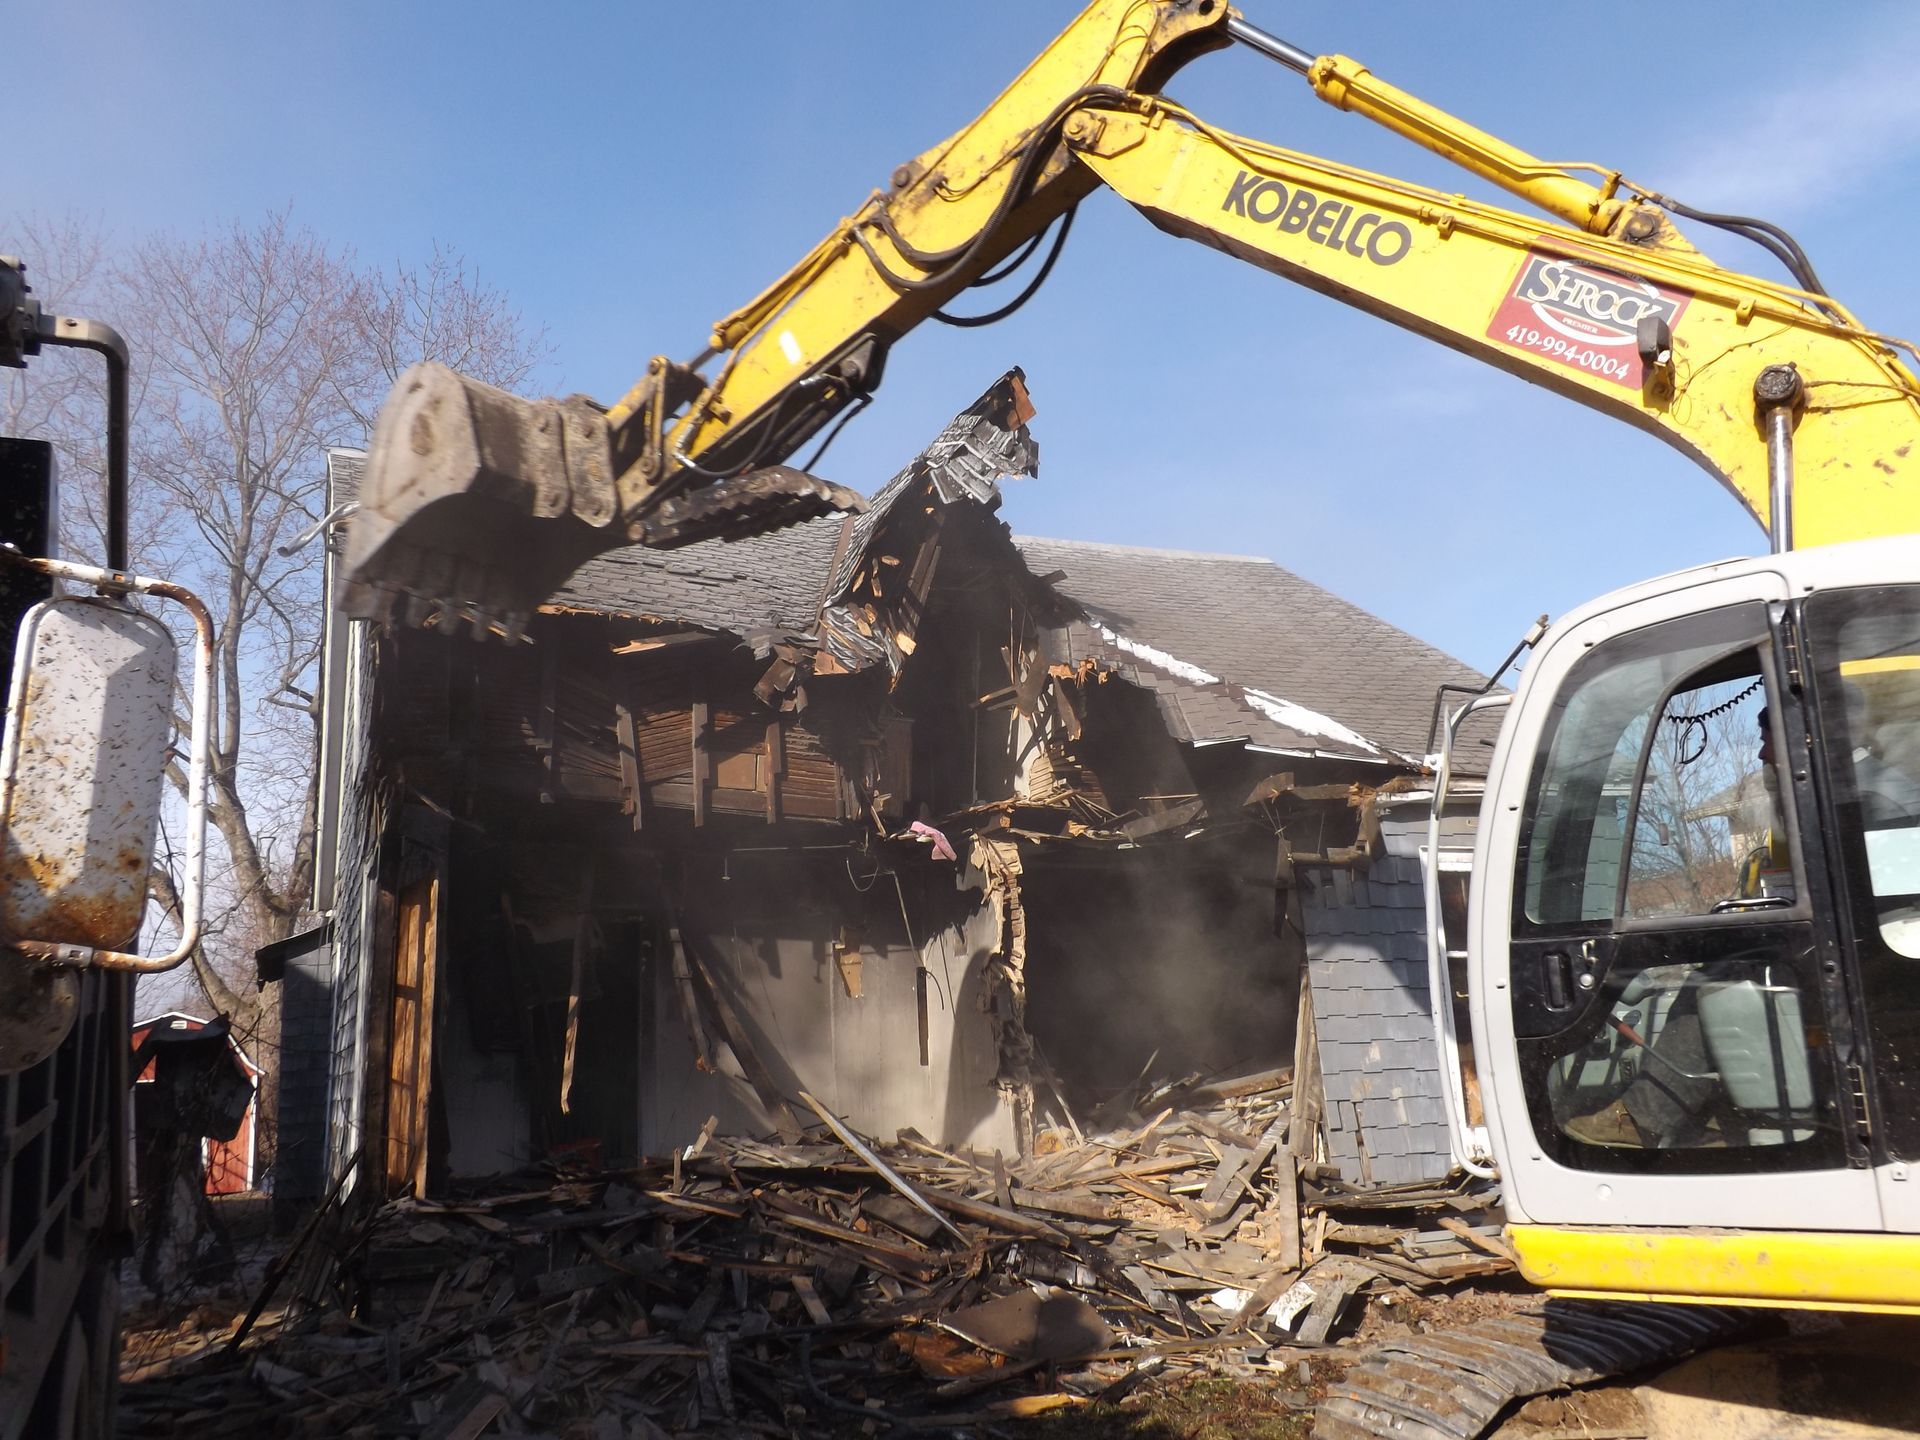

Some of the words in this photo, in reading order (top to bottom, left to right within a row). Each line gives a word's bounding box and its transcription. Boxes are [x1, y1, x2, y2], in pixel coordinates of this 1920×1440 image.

[1221, 170, 1412, 266] KOBELCO
[1527, 263, 1663, 329] SHROCK
[1506, 324, 1630, 380] 419-994-0004
